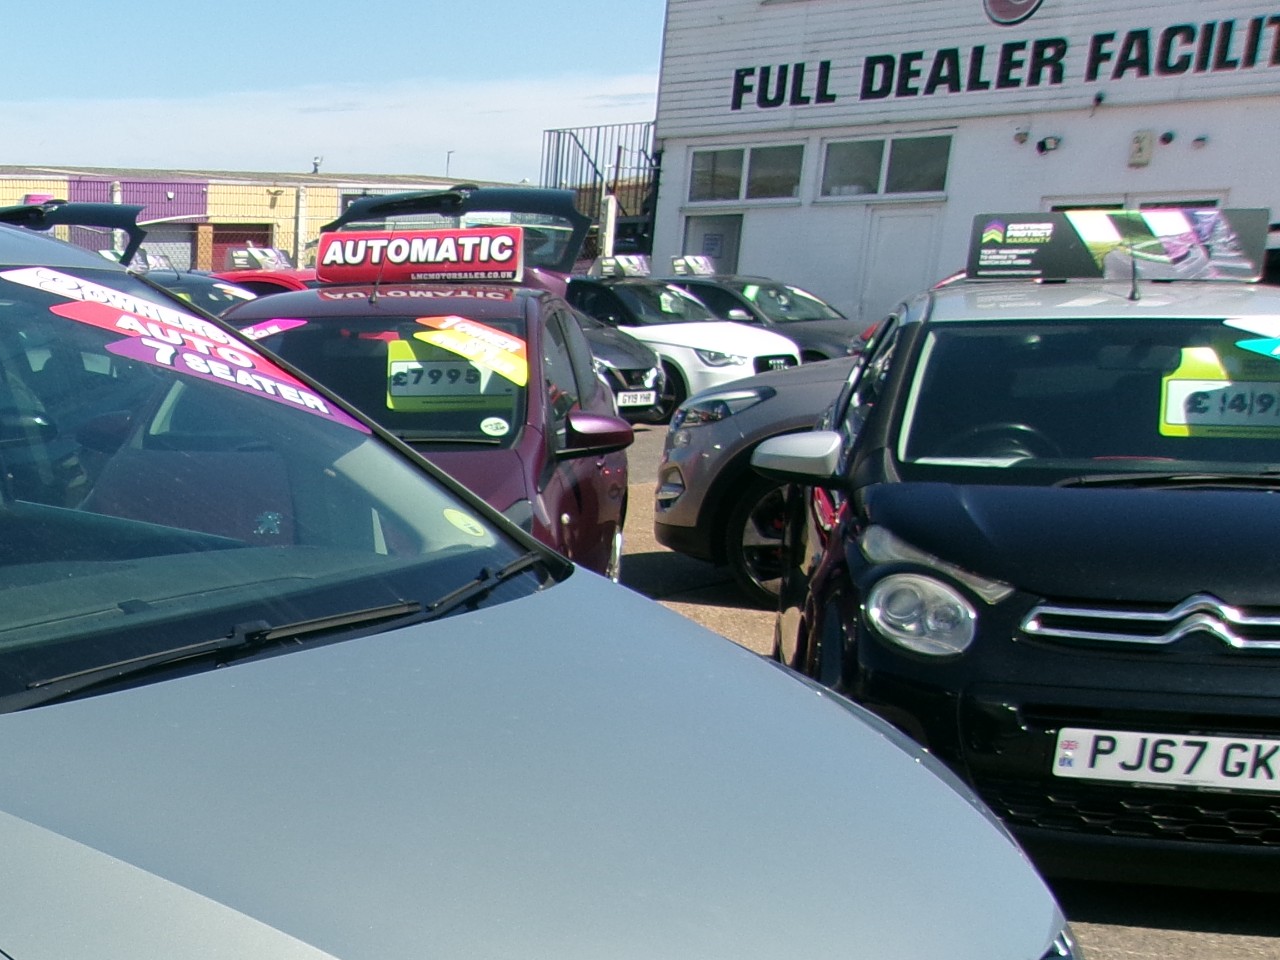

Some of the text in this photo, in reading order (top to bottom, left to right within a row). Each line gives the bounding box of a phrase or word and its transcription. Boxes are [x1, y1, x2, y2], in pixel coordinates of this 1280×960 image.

[730, 59, 837, 111] FULL
[859, 36, 1068, 101] DEALER
[322, 235, 514, 266] AUTOMATIC
[114, 314, 255, 369] AUTO
[140, 337, 330, 414] 7 SEATER
[392, 368, 480, 387] £7995
[1087, 733, 1280, 780] PJ67 GK
